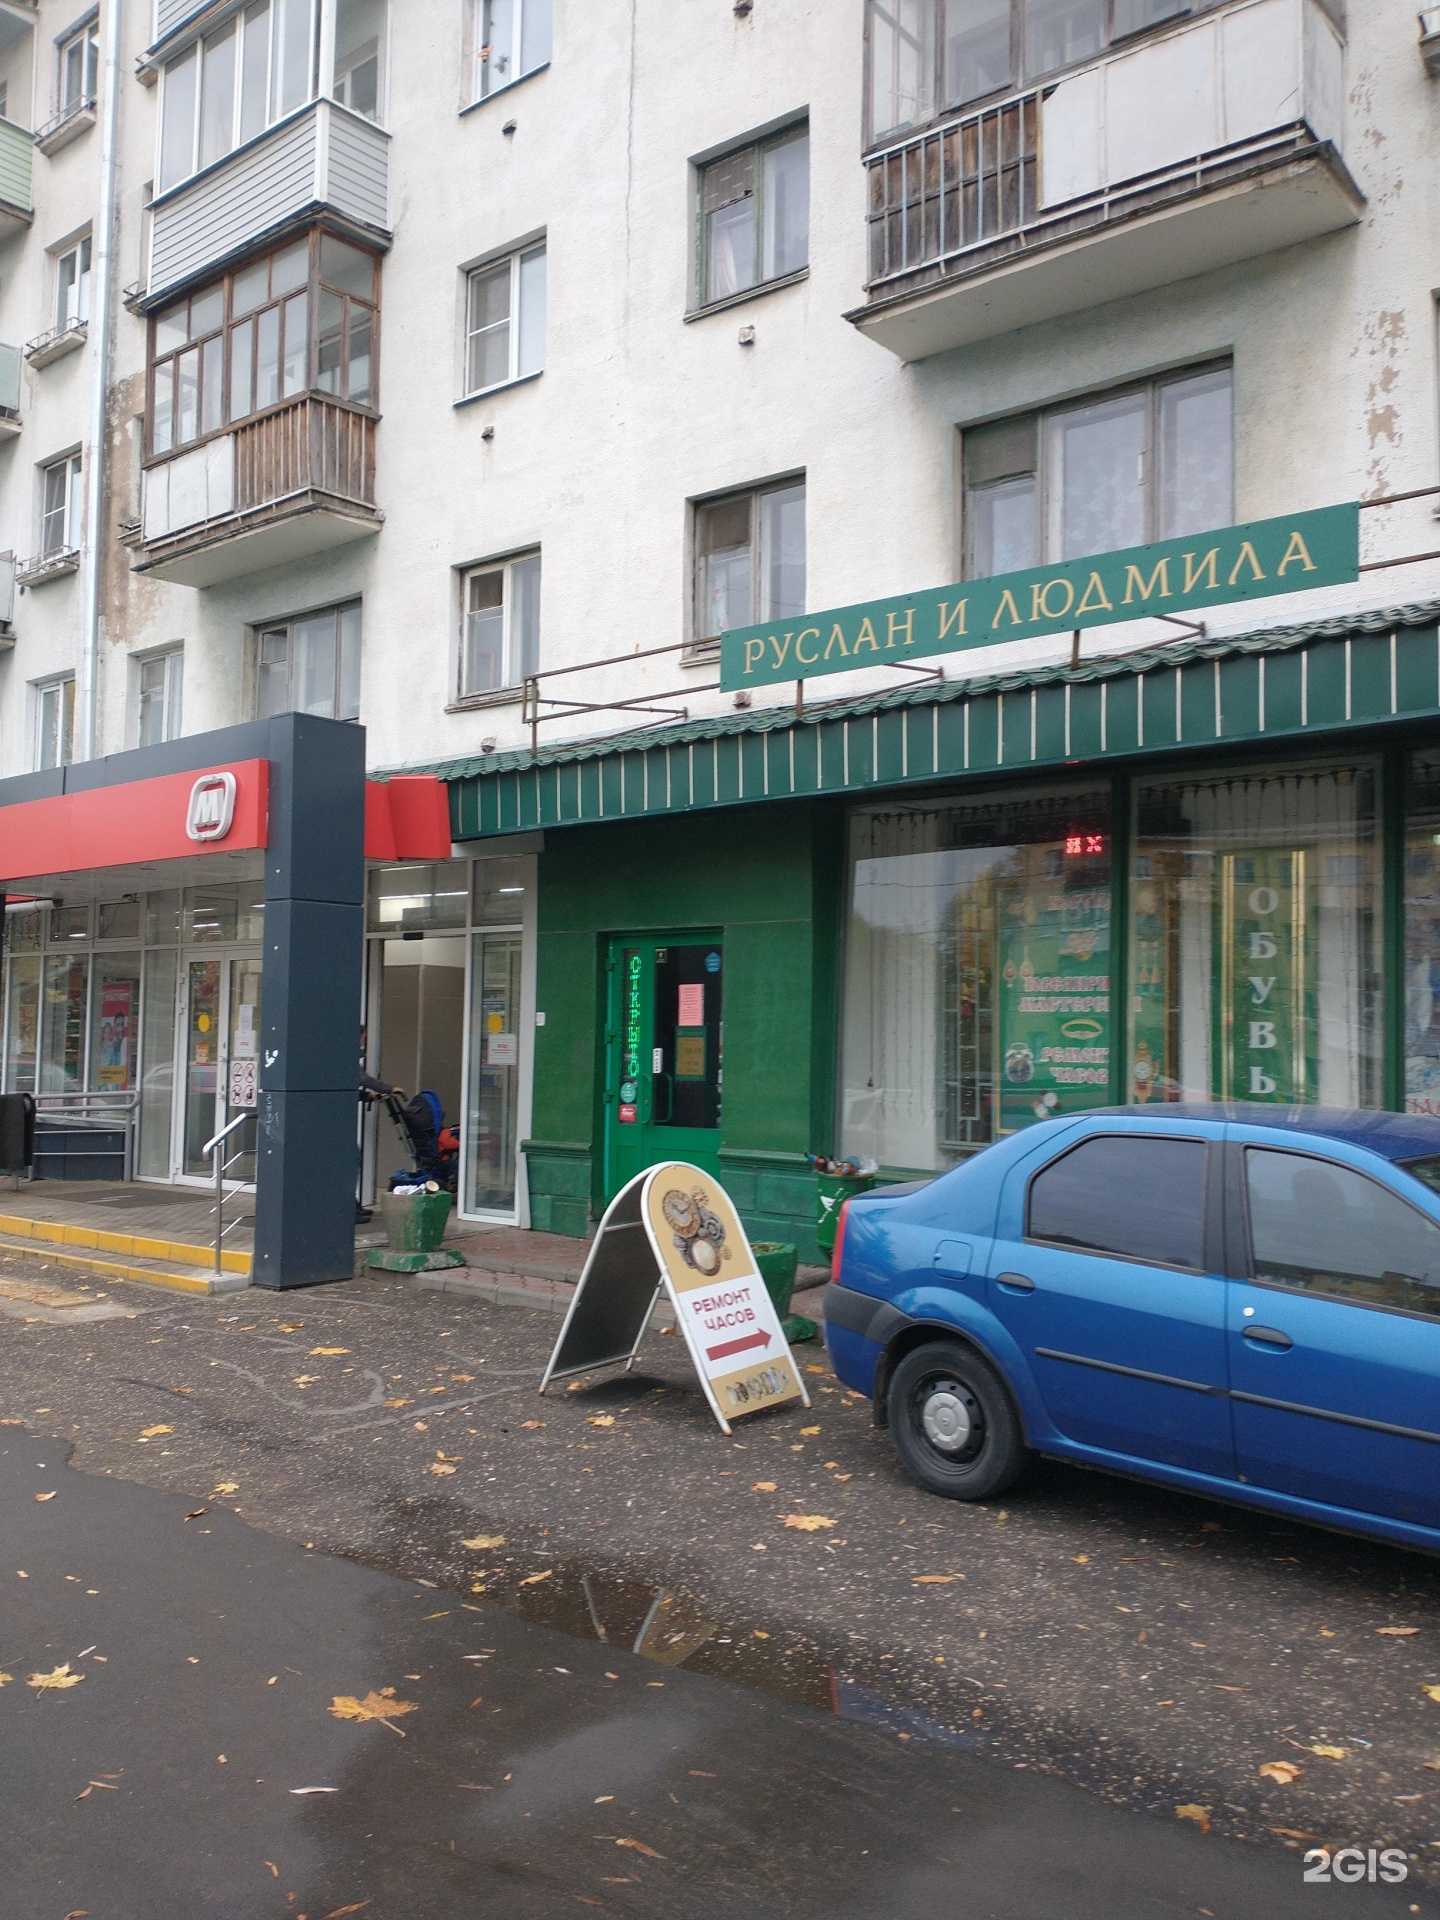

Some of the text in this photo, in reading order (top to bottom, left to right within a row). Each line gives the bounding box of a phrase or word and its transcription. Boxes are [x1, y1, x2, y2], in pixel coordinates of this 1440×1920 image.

[742, 530, 1318, 674] РУСЛАН И ЛЮДМИЛА
[1248, 886, 1279, 1095] ОБУВЬ
[692, 1287, 751, 1315] РЕМОНТ
[704, 1308, 756, 1331] ЧАСОВ
